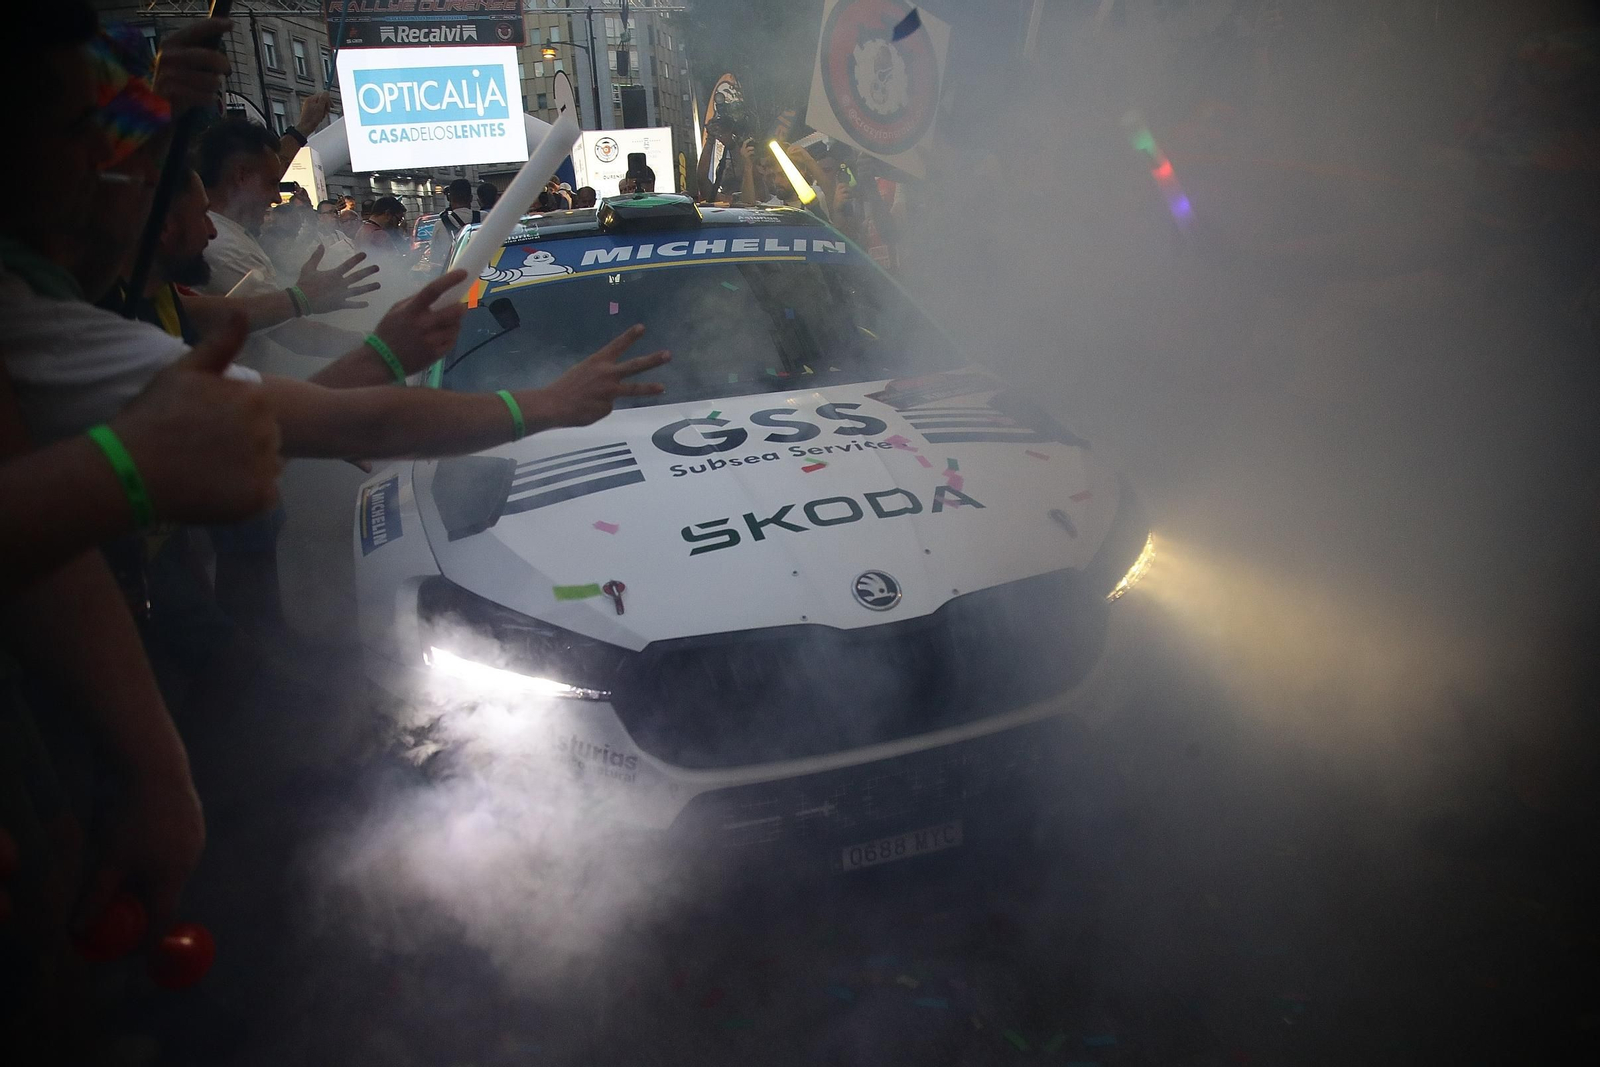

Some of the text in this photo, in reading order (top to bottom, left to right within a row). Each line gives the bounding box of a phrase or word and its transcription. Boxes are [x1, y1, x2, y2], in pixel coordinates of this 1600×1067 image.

[396, 25, 461, 43] Recalvi
[368, 122, 506, 145] CASADELOSLENTES
[580, 238, 846, 266] MICHELIN
[652, 403, 888, 456] GSS
[669, 439, 908, 477] Subsea Service
[371, 492, 388, 546] MICHELIN
[850, 826, 956, 866] 0688 MYC
